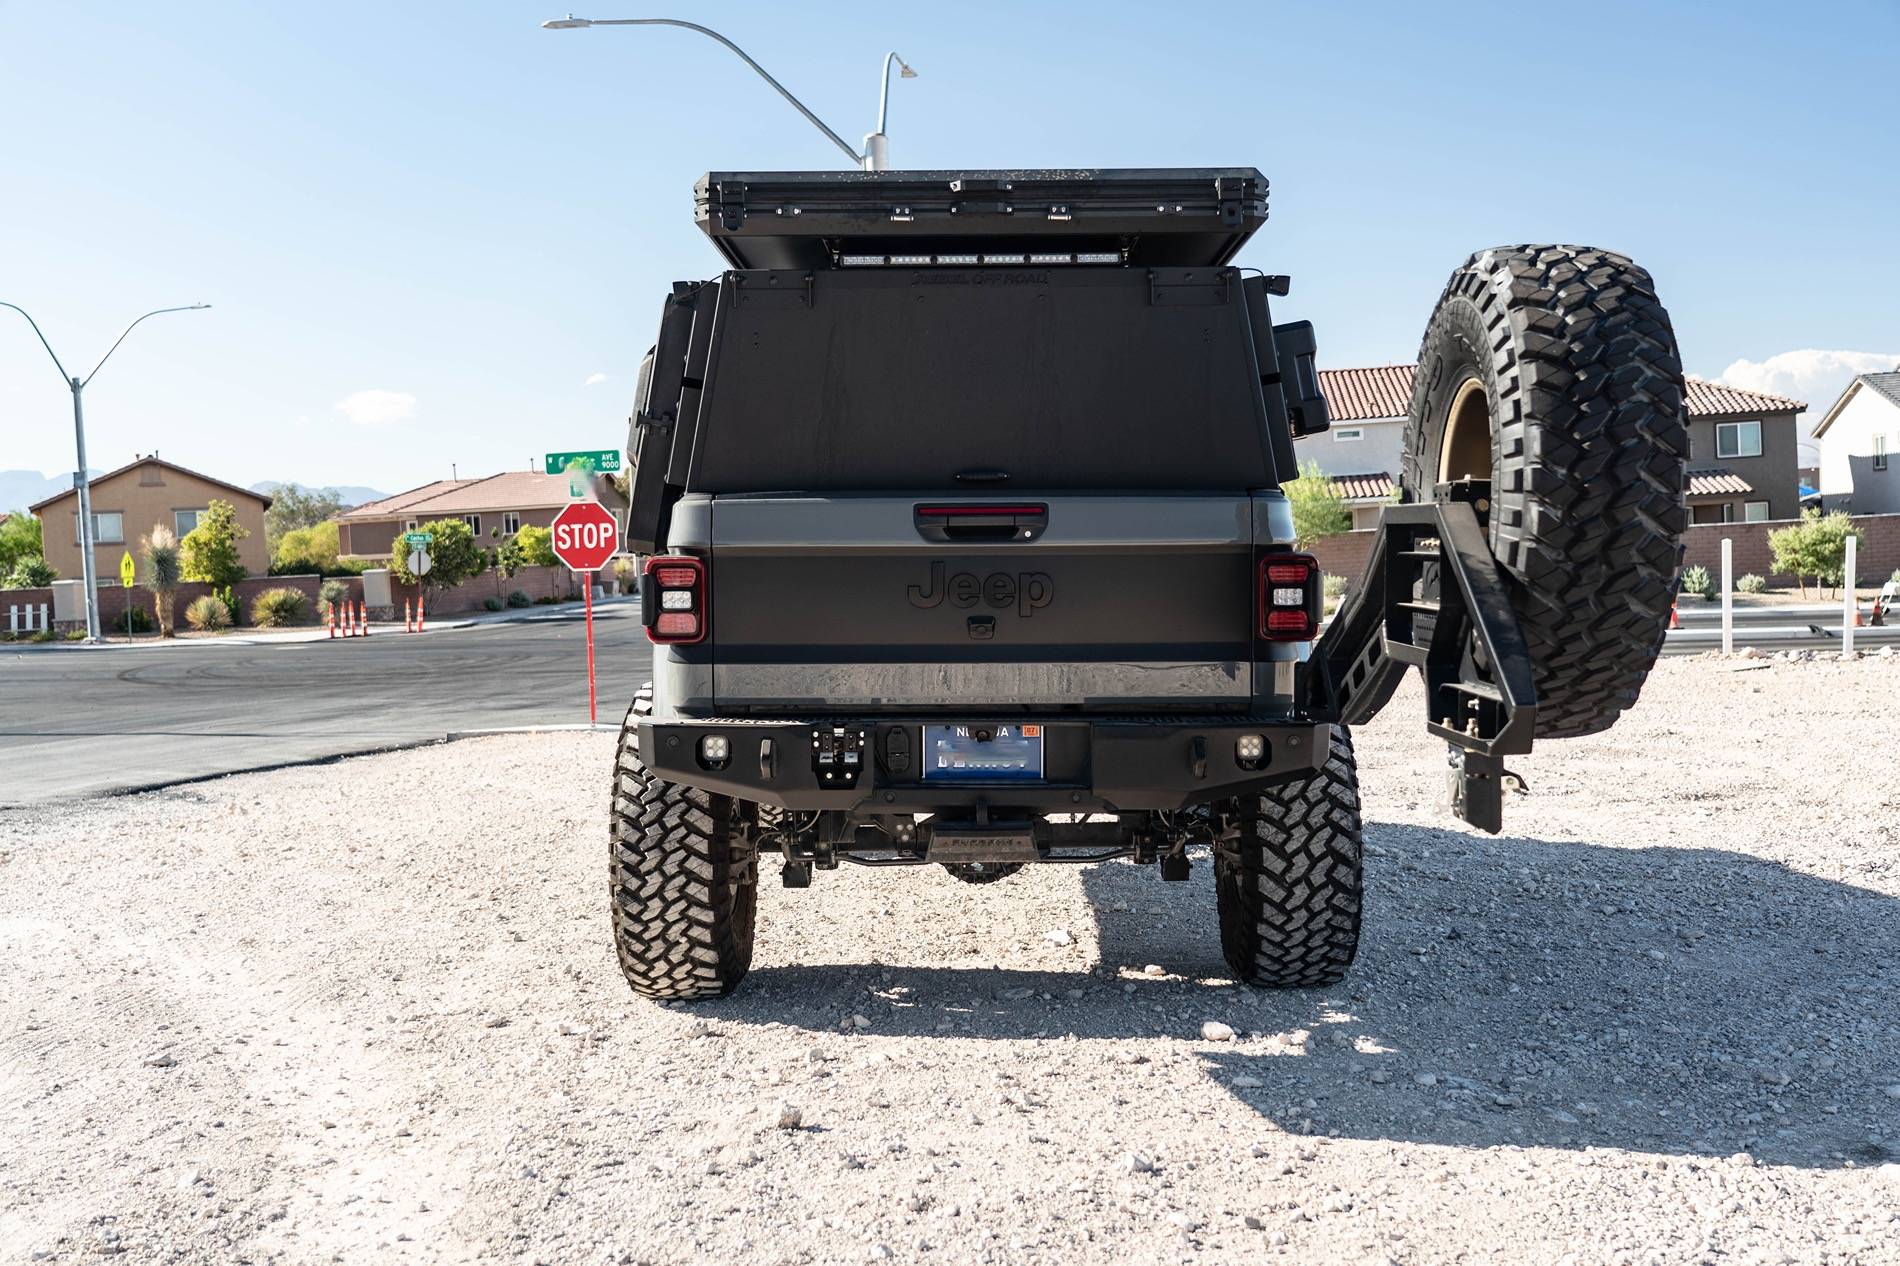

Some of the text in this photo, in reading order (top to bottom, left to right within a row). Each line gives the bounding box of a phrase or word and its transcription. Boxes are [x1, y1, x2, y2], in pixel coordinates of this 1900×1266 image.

[1003, 272, 1048, 285] ROAD
[601, 453, 614, 461] AVE
[601, 461, 619, 469] 9000
[557, 522, 614, 550] STOP
[907, 560, 1054, 618] Jeep
